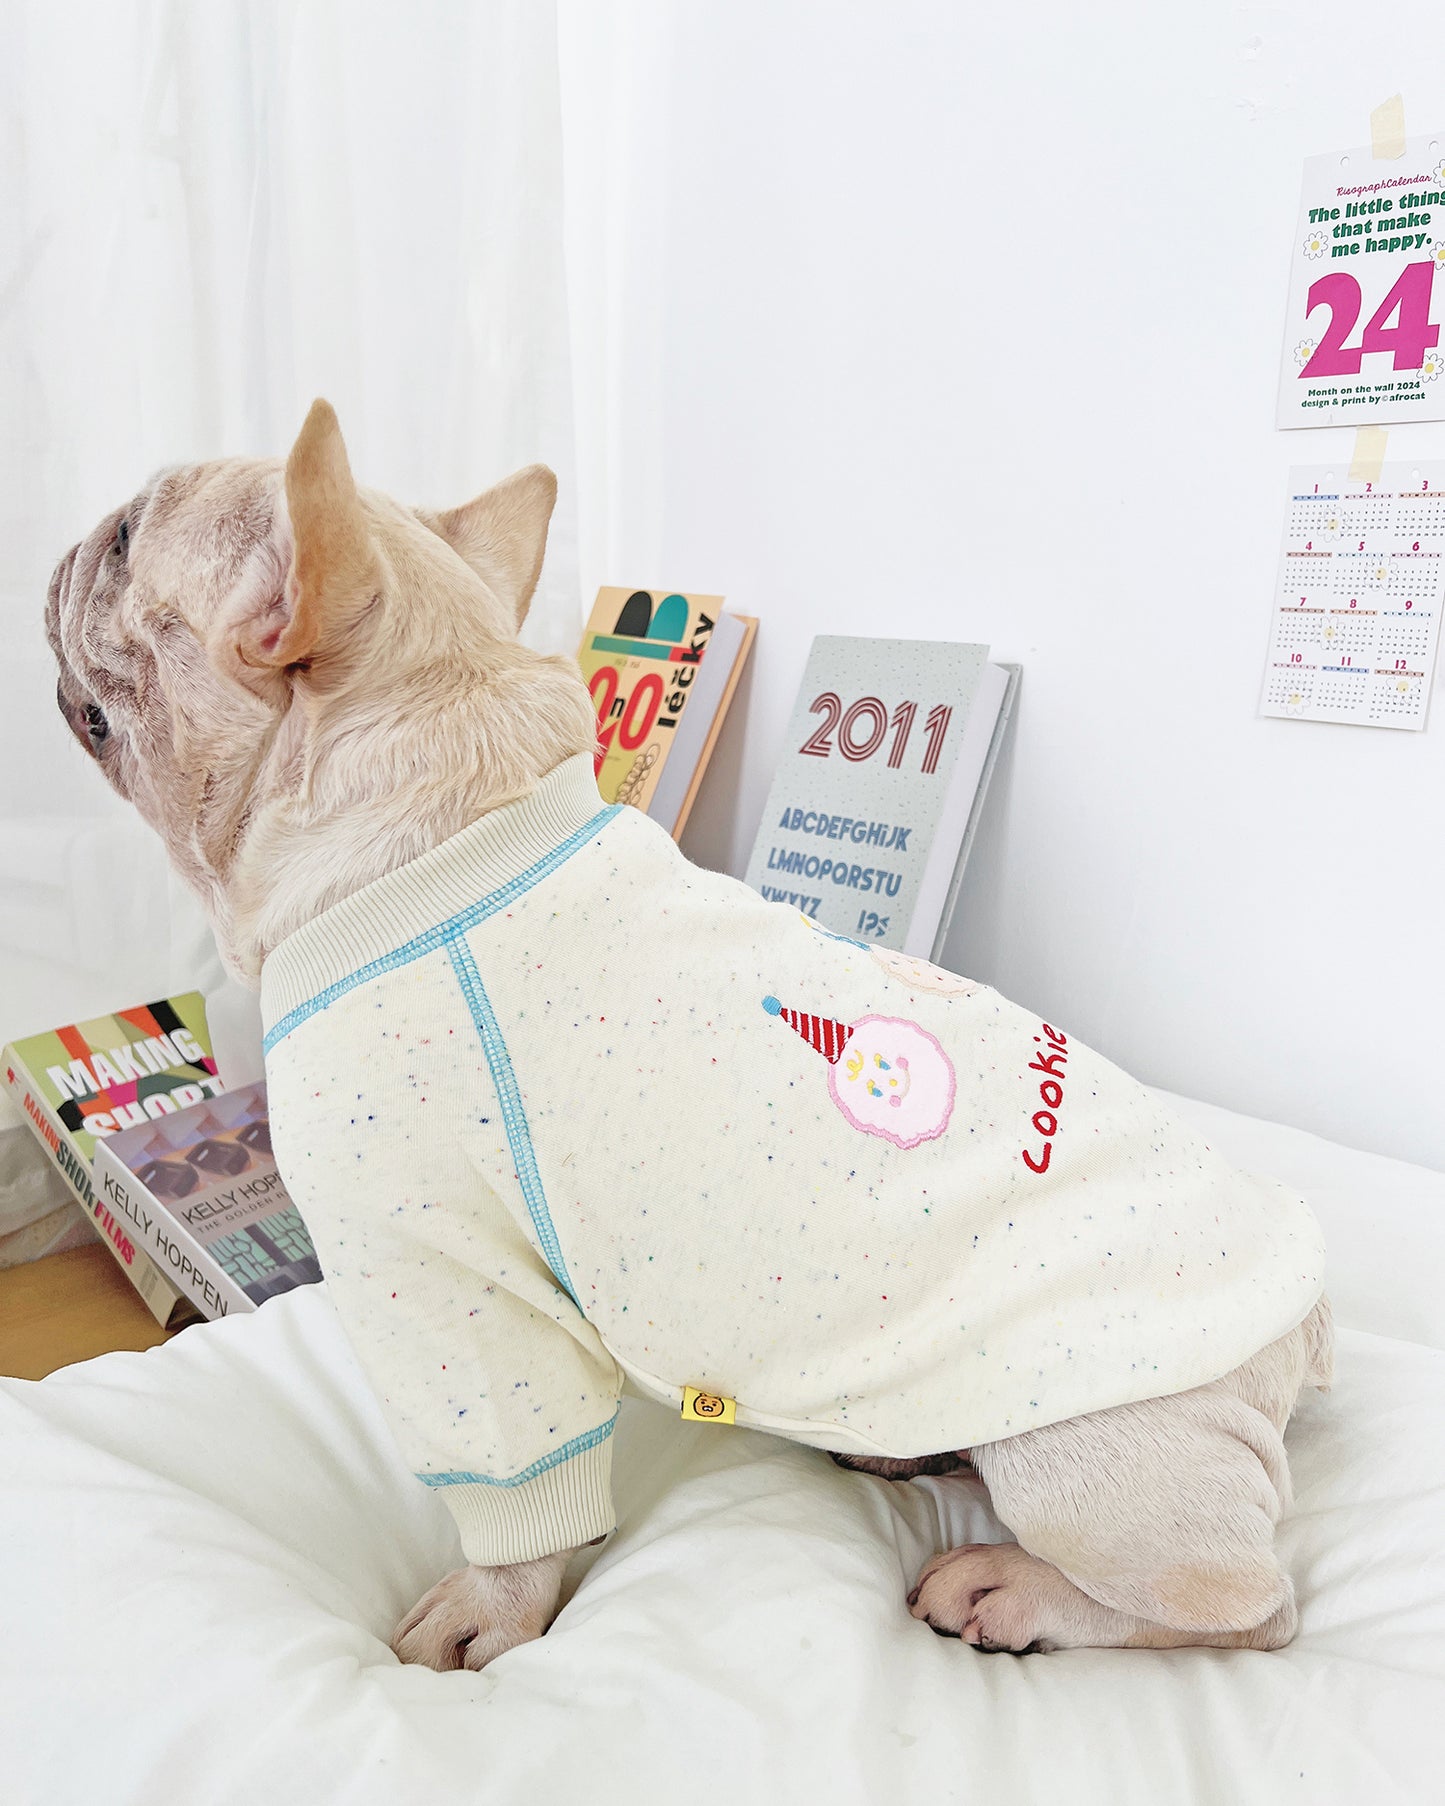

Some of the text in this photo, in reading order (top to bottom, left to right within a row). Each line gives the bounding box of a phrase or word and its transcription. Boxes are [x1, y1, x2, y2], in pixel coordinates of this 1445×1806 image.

[1308, 207, 1340, 224] The
[1345, 198, 1393, 218] little
[1332, 212, 1431, 239] that make
[1331, 232, 1432, 258] me happy.
[1297, 260, 1440, 379] 24
[1301, 397, 1329, 408] design
[1332, 398, 1339, 406] &
[1341, 396, 1366, 407] print
[1308, 381, 1420, 397] Month on the wall 2024
[1314, 480, 1429, 494] 1 2 3
[1305, 541, 1420, 551] 4 5 6
[1300, 597, 1413, 610] 7 8 9
[1291, 653, 1407, 670] 10 11 12
[798, 691, 953, 775] 2011
[767, 847, 902, 898] LMNOPQRSTU
[46, 1027, 207, 1100] MAKING
[181, 1190, 238, 1225] KELLY
[104, 1172, 232, 1317] KELLY HOPPEN
